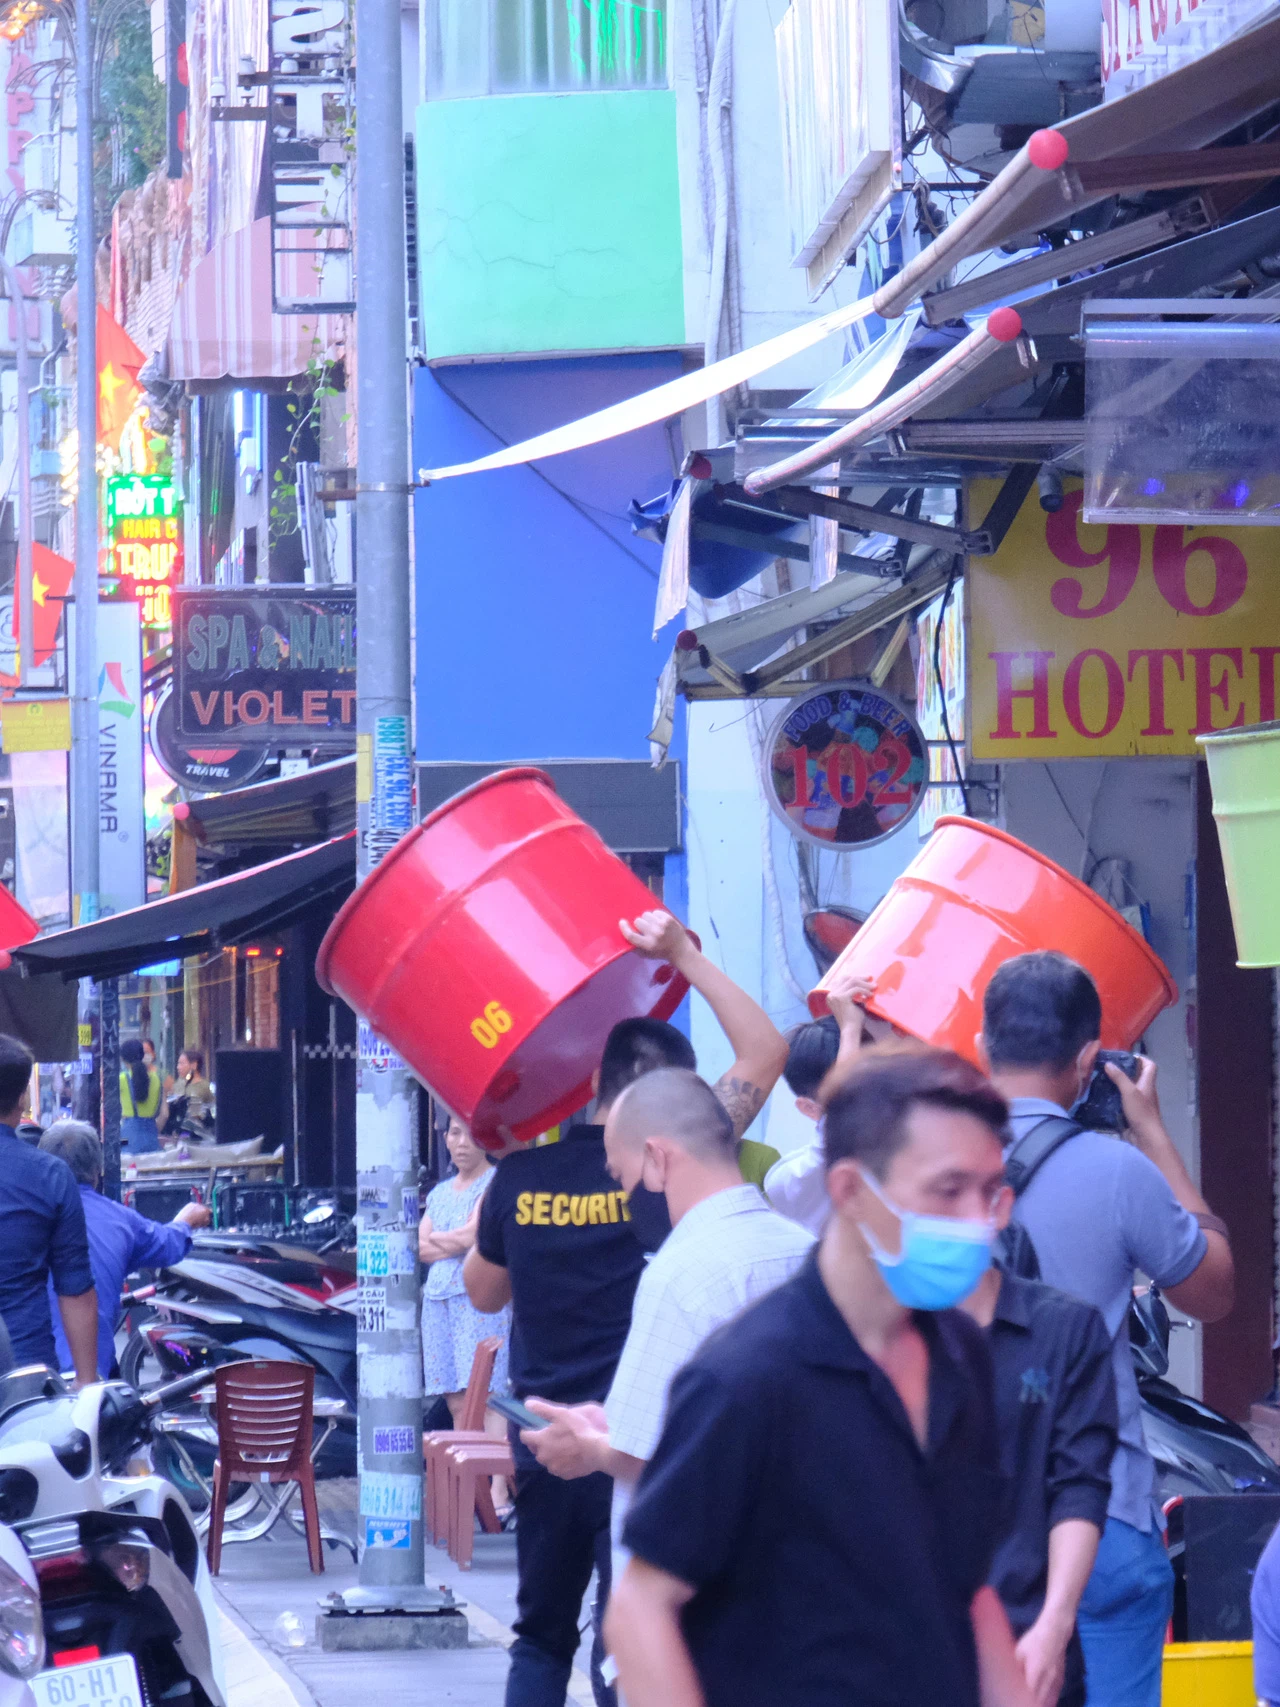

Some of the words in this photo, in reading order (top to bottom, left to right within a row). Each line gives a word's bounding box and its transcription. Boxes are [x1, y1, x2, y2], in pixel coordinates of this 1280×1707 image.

[122, 519, 161, 539] HAIR
[1045, 489, 1248, 618] 96
[186, 614, 250, 670] SPA
[257, 624, 280, 670] &
[190, 689, 357, 725] VIOLET
[783, 694, 832, 742] FOOD
[838, 691, 853, 711] &
[861, 693, 911, 738] BEER
[186, 763, 230, 778] TRAVEL
[785, 740, 915, 808] 102
[470, 1001, 513, 1049] 06
[46, 1666, 117, 1706] 60-H1
